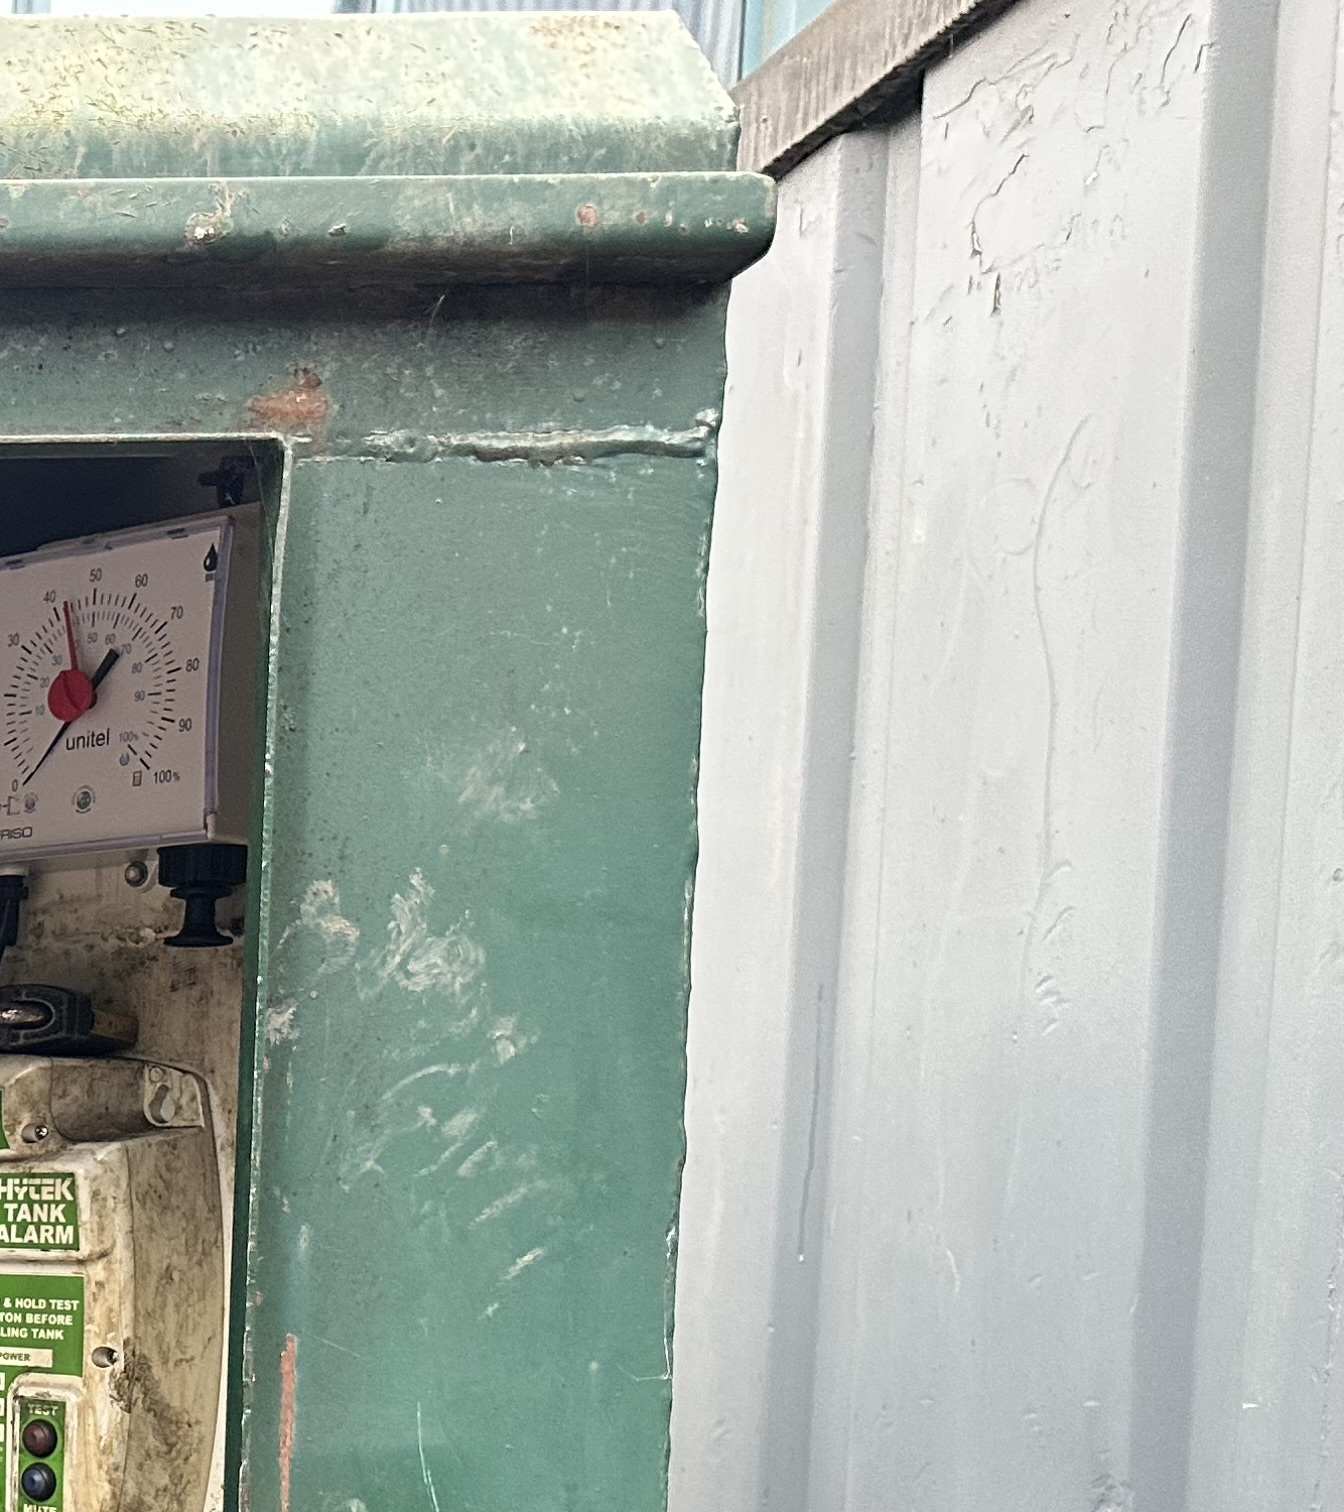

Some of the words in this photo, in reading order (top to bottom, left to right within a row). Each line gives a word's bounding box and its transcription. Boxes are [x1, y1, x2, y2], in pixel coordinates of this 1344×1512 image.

[89, 568, 102, 582] 50
[135, 573, 148, 588] 60
[44, 590, 56, 603] 40
[171, 606, 184, 619] 70
[8, 633, 19, 648] 30
[186, 657, 200, 671] 80
[178, 717, 192, 732] 90
[65, 728, 111, 751] unitel
[153, 770, 181, 785] 100%
[12, 779, 18, 792] 0
[4, 1203, 66, 1223] TANK
[3, 1297, 12, 1308] &
[15, 1298, 46, 1310] HOLD
[49, 1299, 80, 1311] TEST
[25, 1313, 73, 1325] BEFORE
[31, 1328, 64, 1340] TANK
[27, 1402, 59, 1416] TEST
